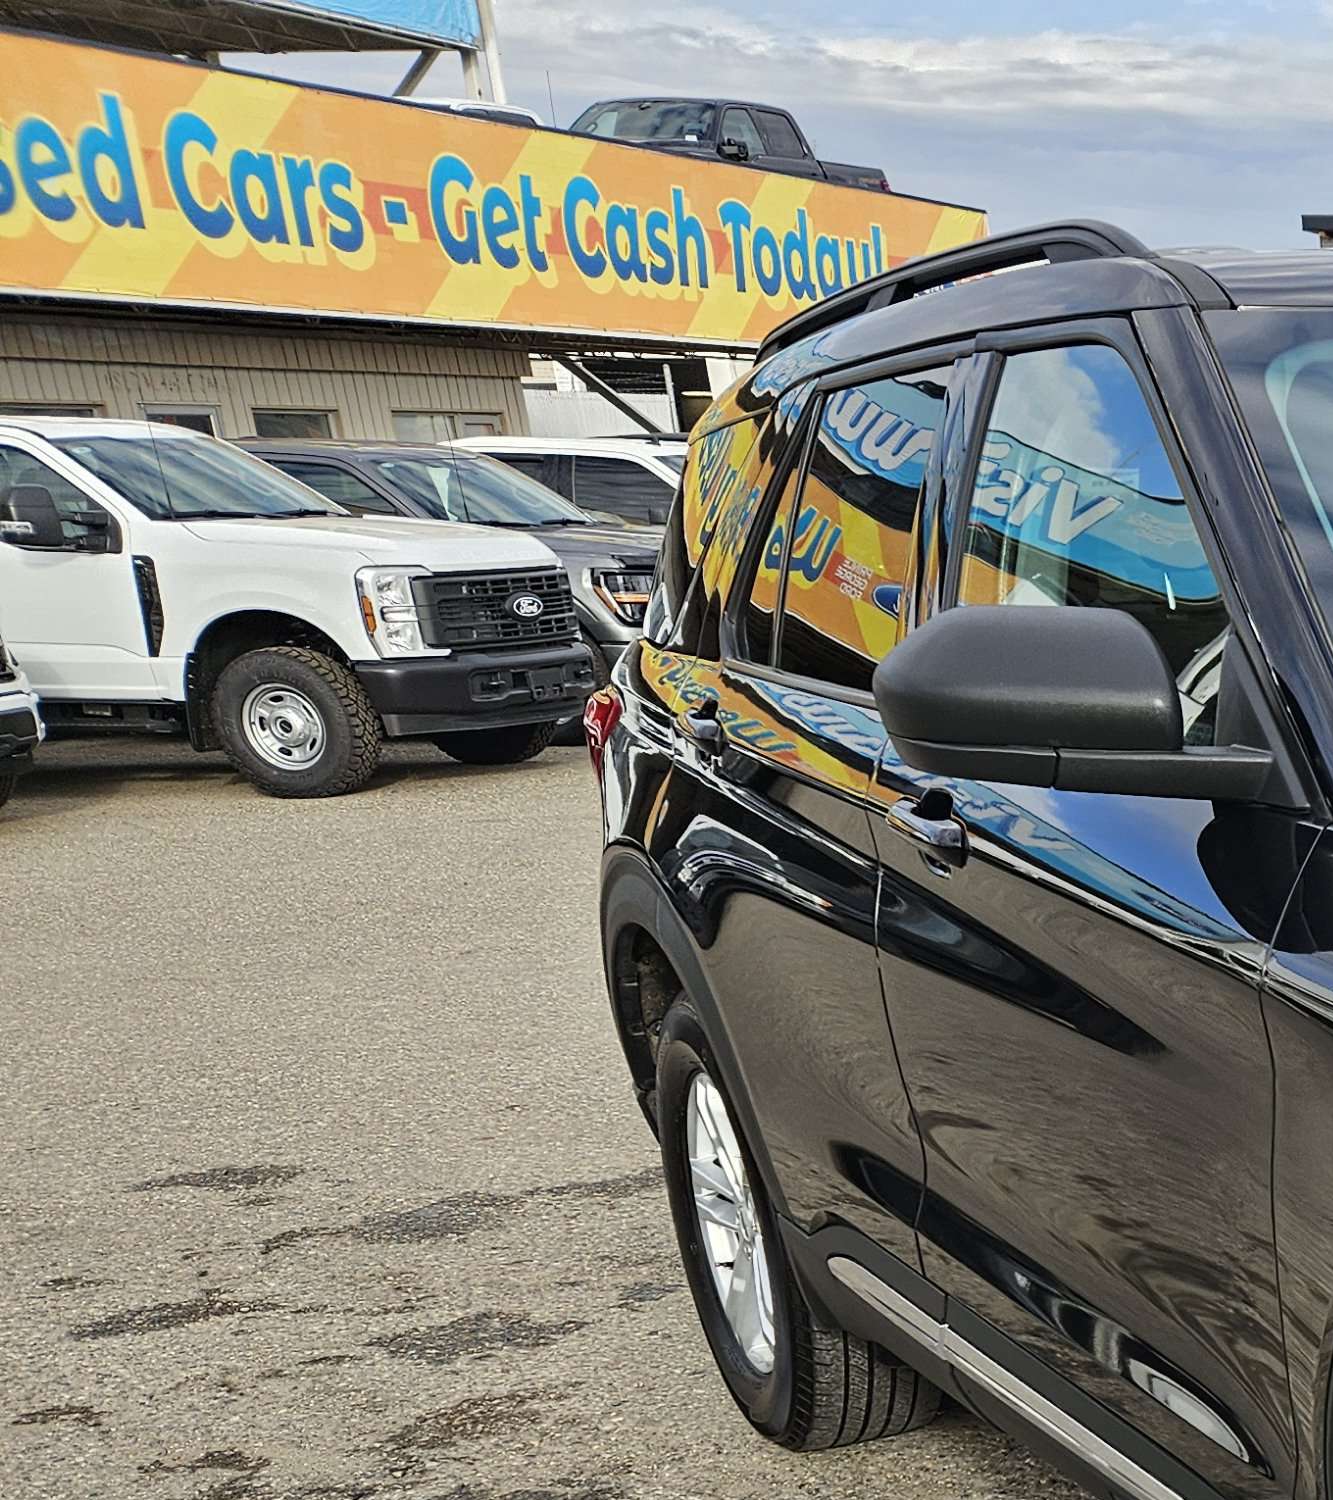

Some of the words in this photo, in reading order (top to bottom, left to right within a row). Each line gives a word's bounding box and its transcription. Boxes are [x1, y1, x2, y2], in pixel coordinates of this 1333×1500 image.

[163, 110, 366, 254] Cars
[429, 154, 550, 272] Get
[562, 175, 710, 289] Cash
